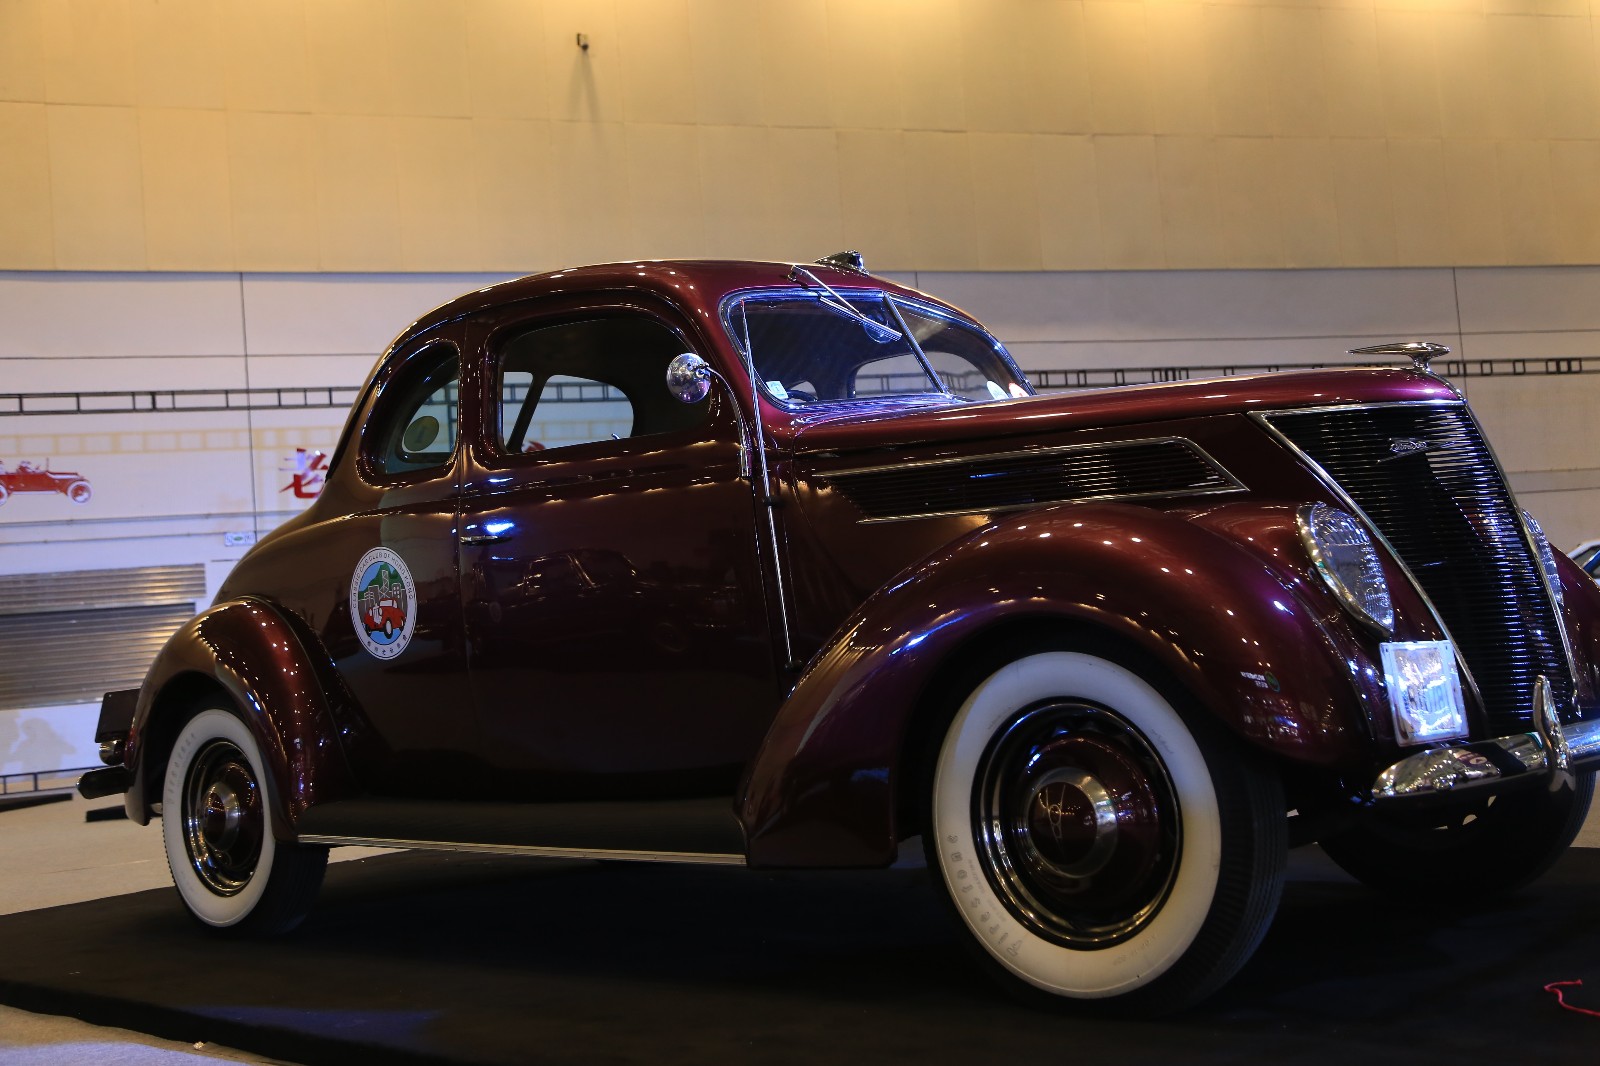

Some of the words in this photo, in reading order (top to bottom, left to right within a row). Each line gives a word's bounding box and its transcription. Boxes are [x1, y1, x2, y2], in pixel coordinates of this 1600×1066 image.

[360, 558, 370, 573] CAR
[368, 552, 383, 561] CLUB
[404, 575, 414, 600] KONG
